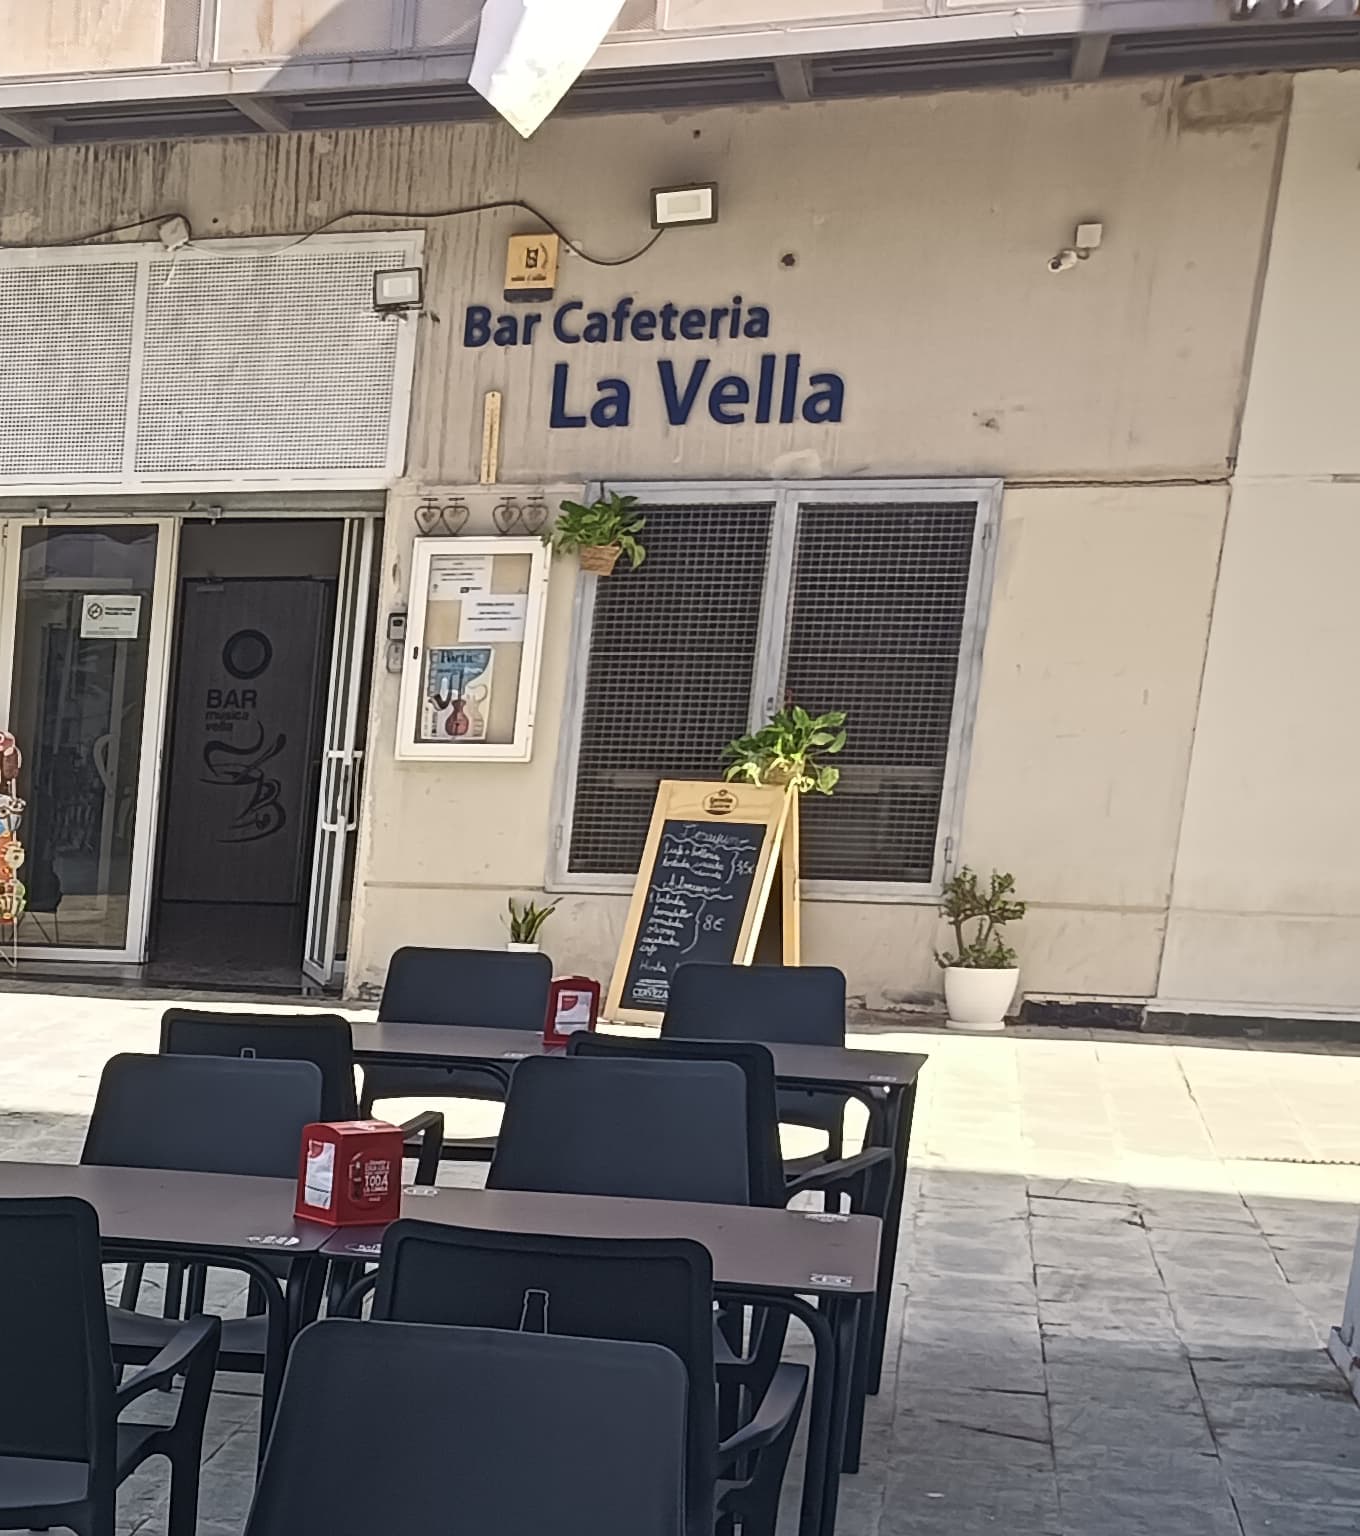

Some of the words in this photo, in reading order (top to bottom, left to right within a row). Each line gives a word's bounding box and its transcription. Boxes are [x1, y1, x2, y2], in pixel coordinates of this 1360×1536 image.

[463, 305, 542, 348] Bar
[553, 295, 770, 344] Cafeteria
[550, 362, 630, 429] La
[658, 353, 846, 425] Vella
[206, 689, 258, 709] BAR
